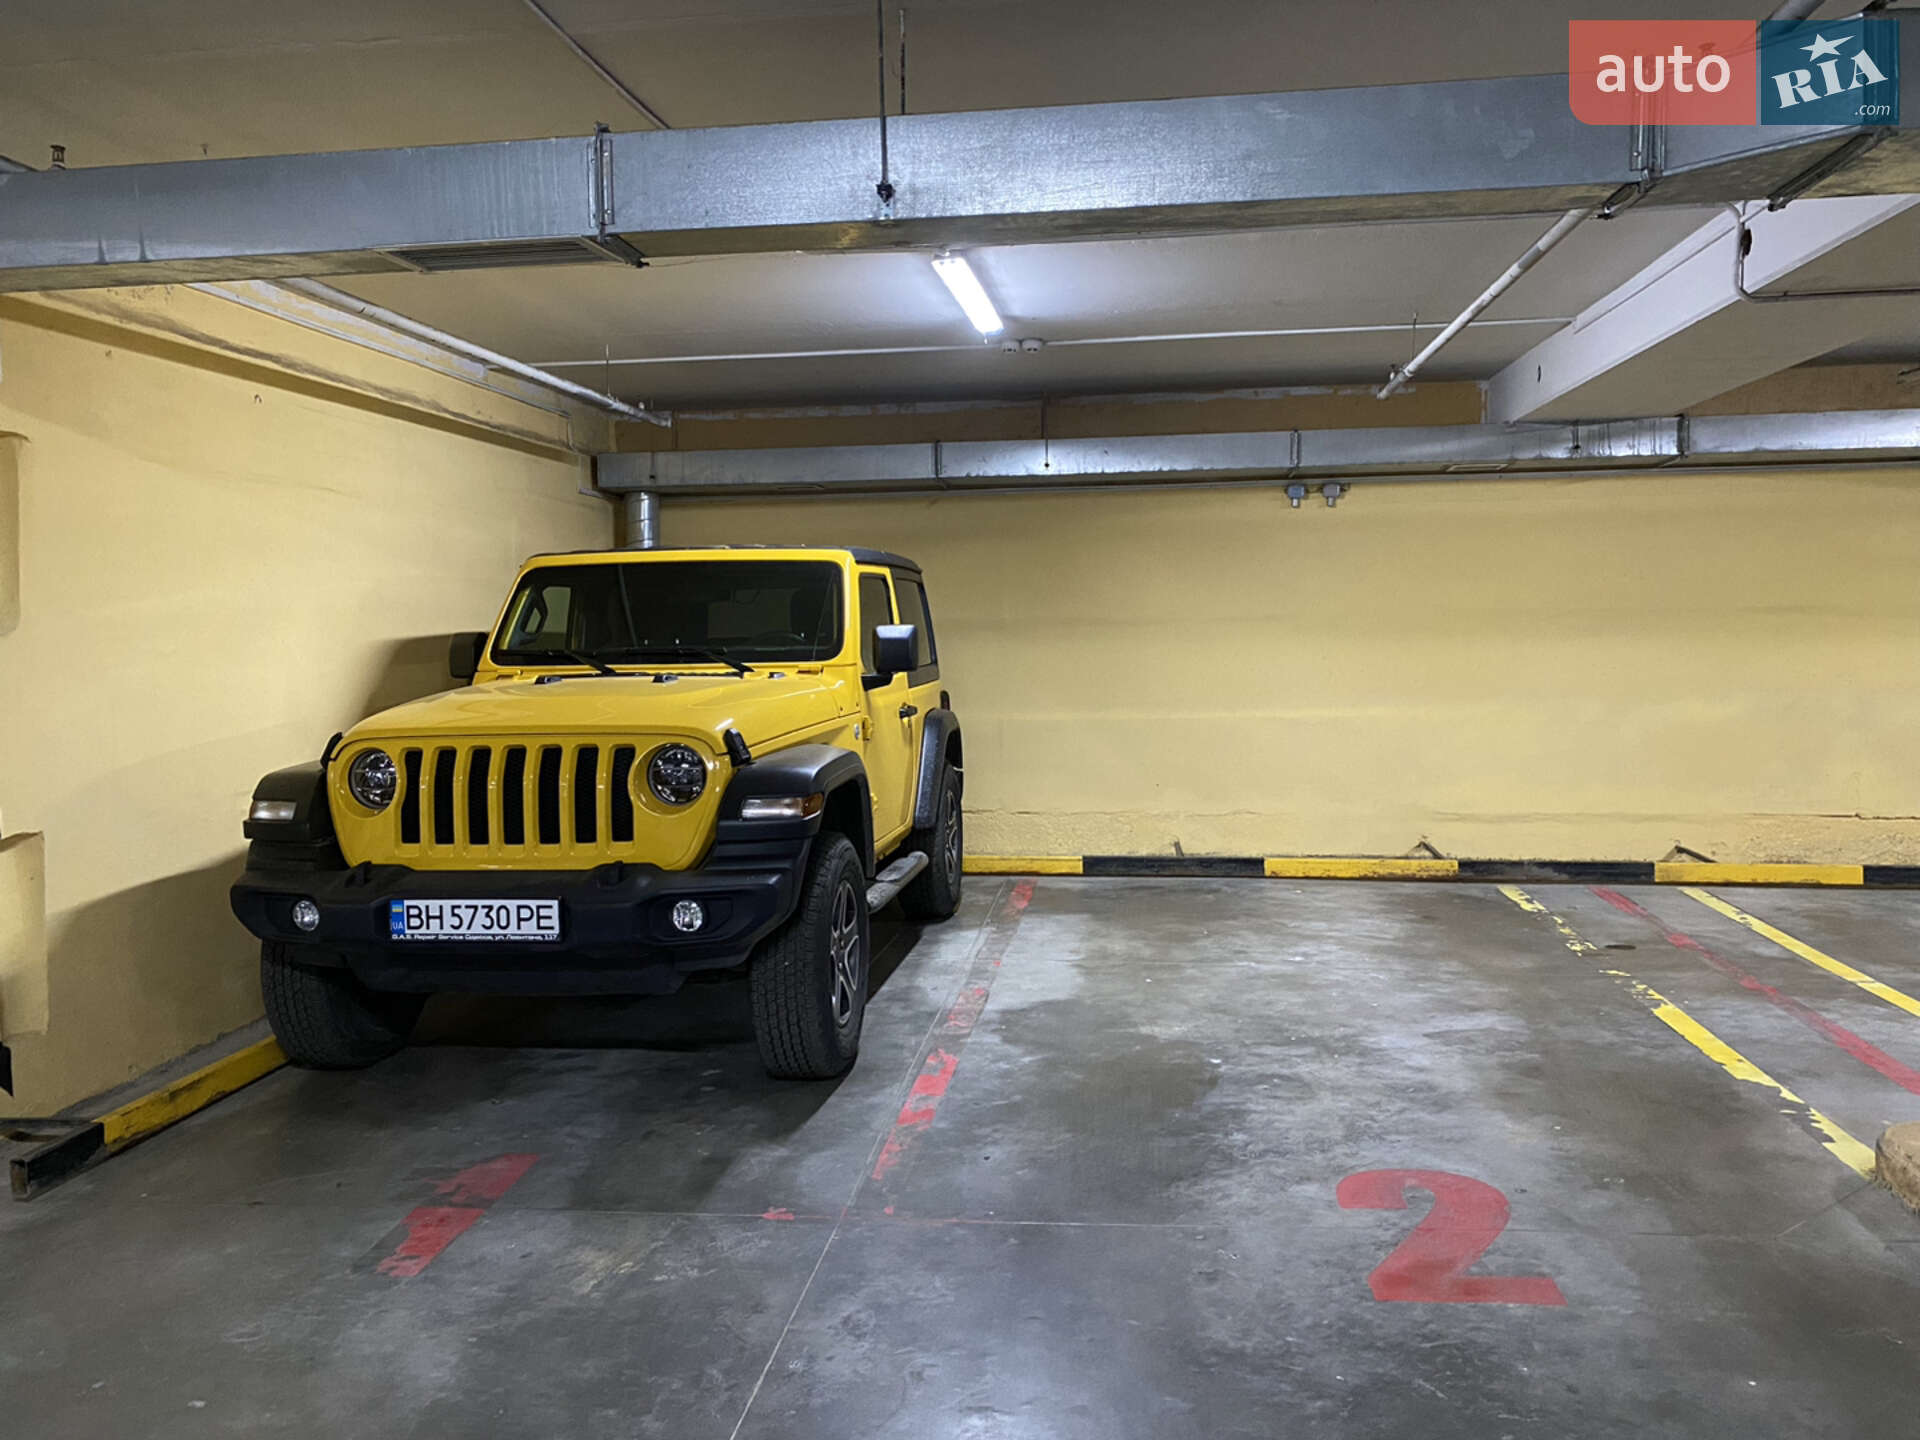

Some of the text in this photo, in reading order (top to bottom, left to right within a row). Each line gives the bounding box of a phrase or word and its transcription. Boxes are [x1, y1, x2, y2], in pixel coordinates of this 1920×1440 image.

[392, 921, 404, 931] UA
[449, 904, 511, 931] 5730
[1336, 1168, 1568, 1306] 2
